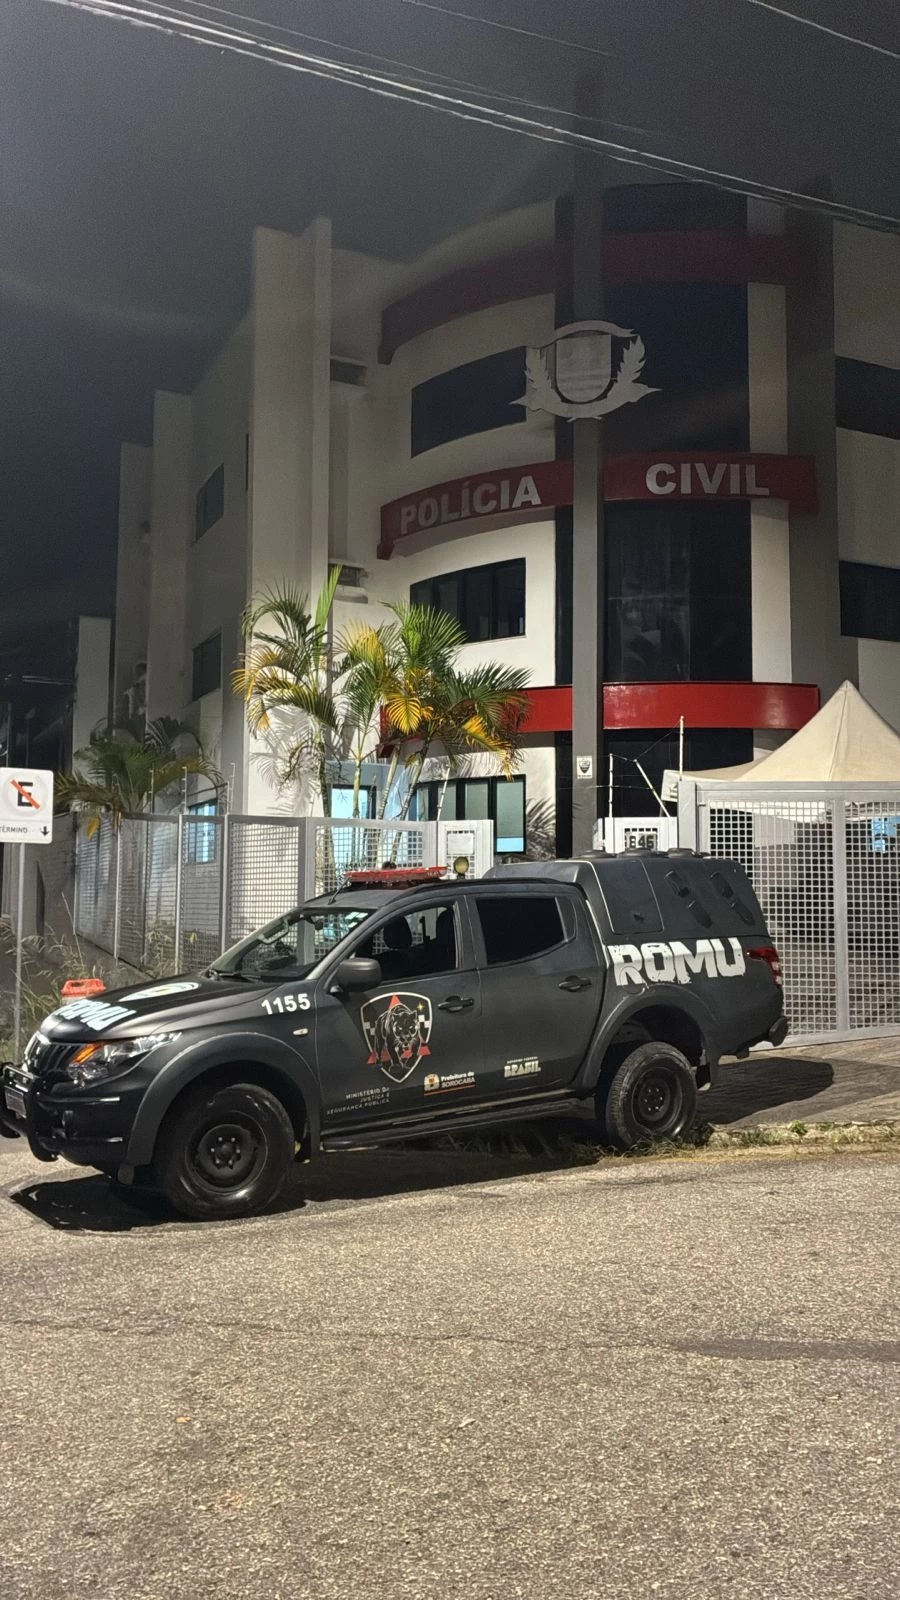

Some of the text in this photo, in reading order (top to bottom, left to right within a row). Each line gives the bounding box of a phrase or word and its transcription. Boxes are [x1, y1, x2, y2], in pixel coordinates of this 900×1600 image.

[400, 463, 770, 534] POLÍCIA CIVIL
[607, 937, 745, 987] ROMU
[261, 993, 310, 1015] 1155
[504, 1060, 541, 1078] BRASIL
[441, 1077, 476, 1089] SOROCABA
